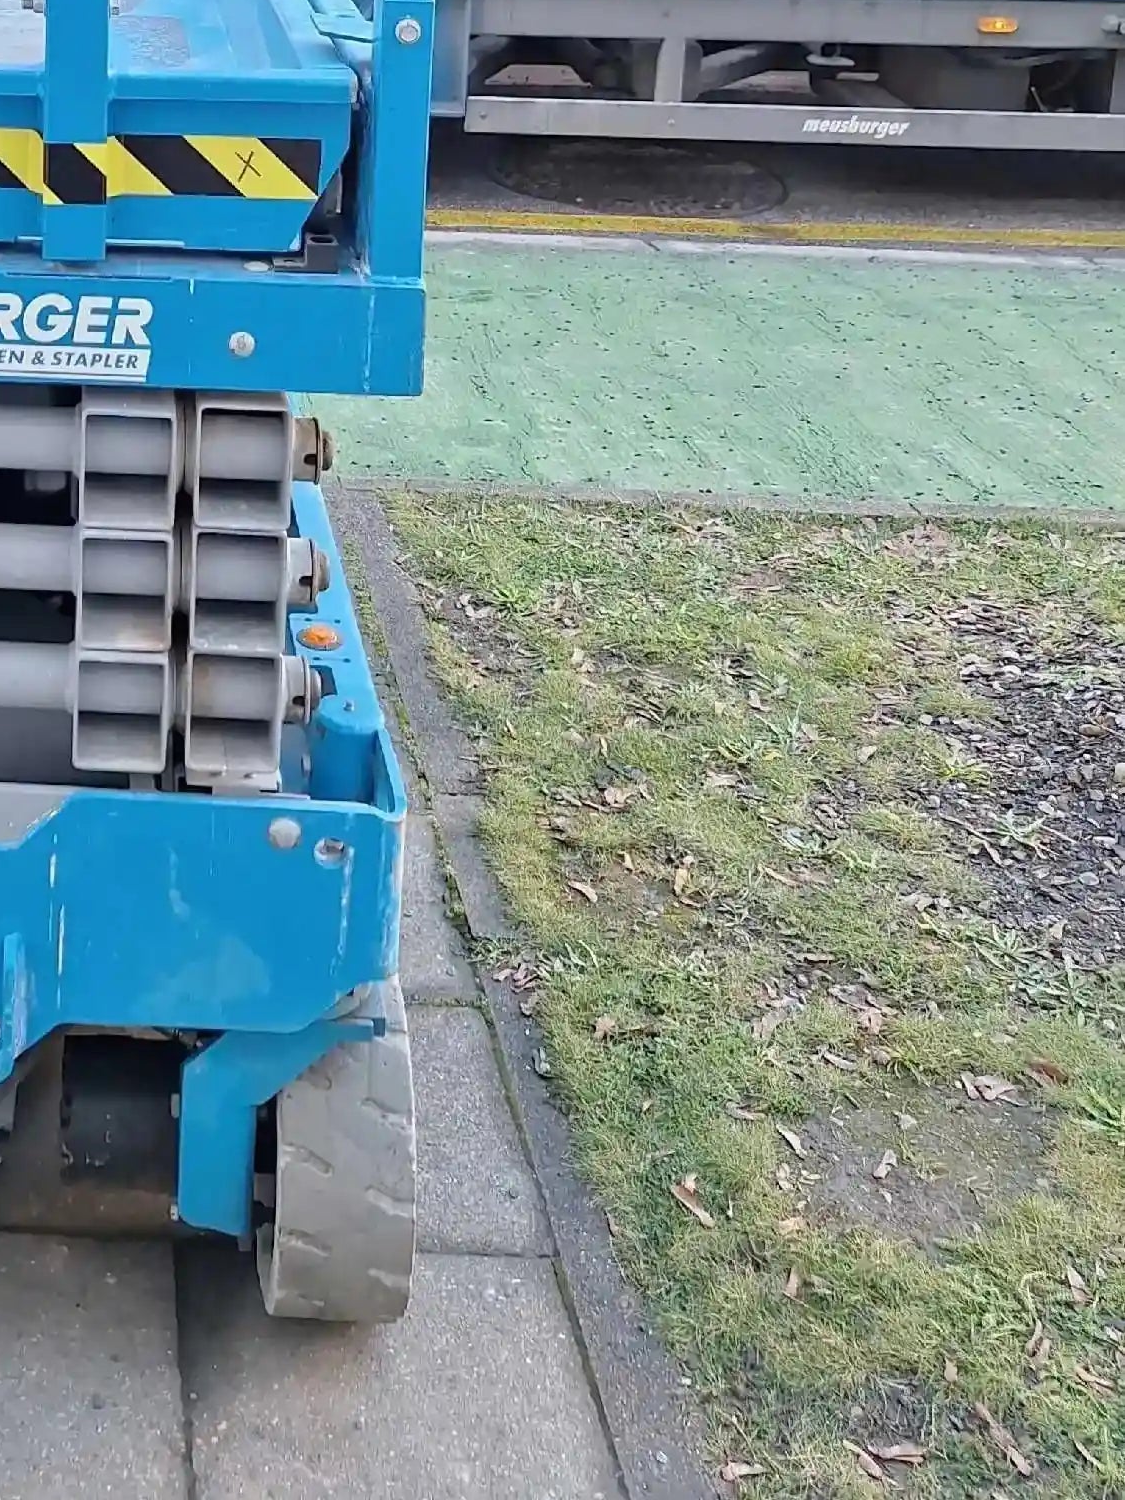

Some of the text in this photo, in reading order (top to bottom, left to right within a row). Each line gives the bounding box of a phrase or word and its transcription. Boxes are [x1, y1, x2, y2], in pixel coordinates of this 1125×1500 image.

[802, 115, 911, 139] meusburger
[30, 349, 46, 366] &
[50, 350, 139, 370] STAPLER
